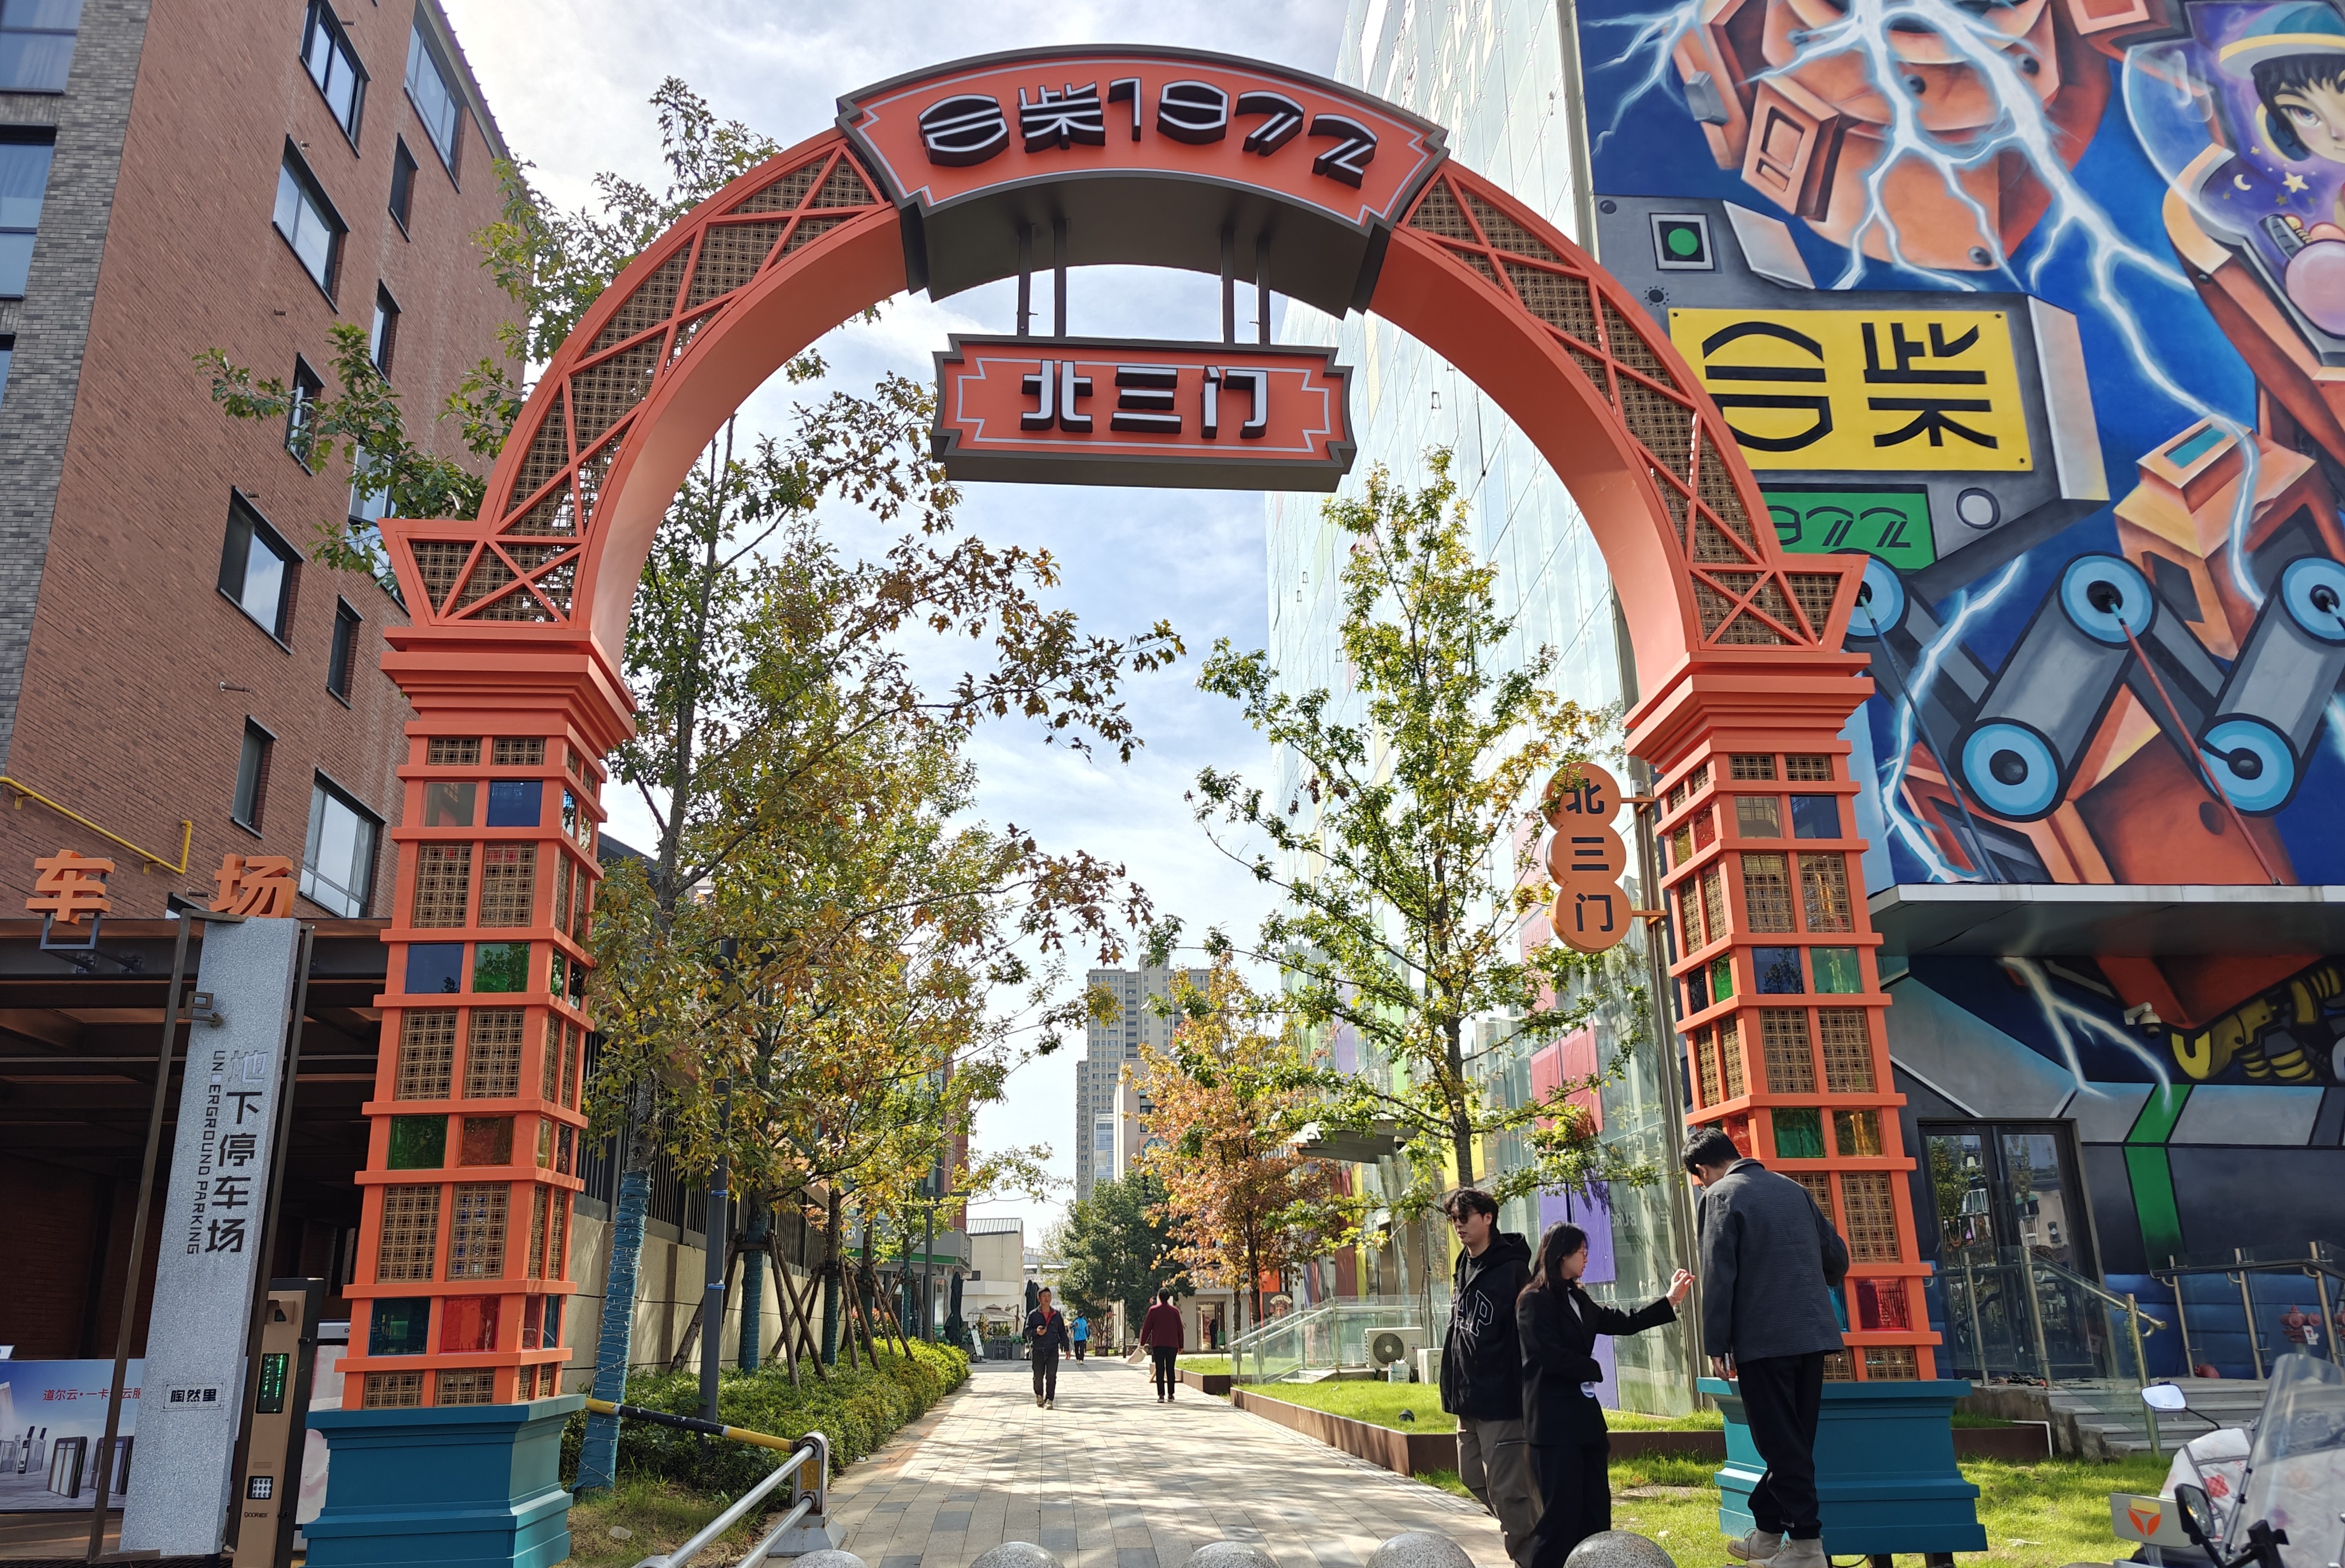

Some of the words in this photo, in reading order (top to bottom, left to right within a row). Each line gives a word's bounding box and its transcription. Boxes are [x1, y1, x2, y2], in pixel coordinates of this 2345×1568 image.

[1021, 358, 1268, 438] 北三门
[1565, 778, 1614, 932] 北三门
[204, 1049, 269, 1253] 地下停车场
[187, 1180, 208, 1255] PARKING
[170, 1388, 217, 1403] 陶然里
